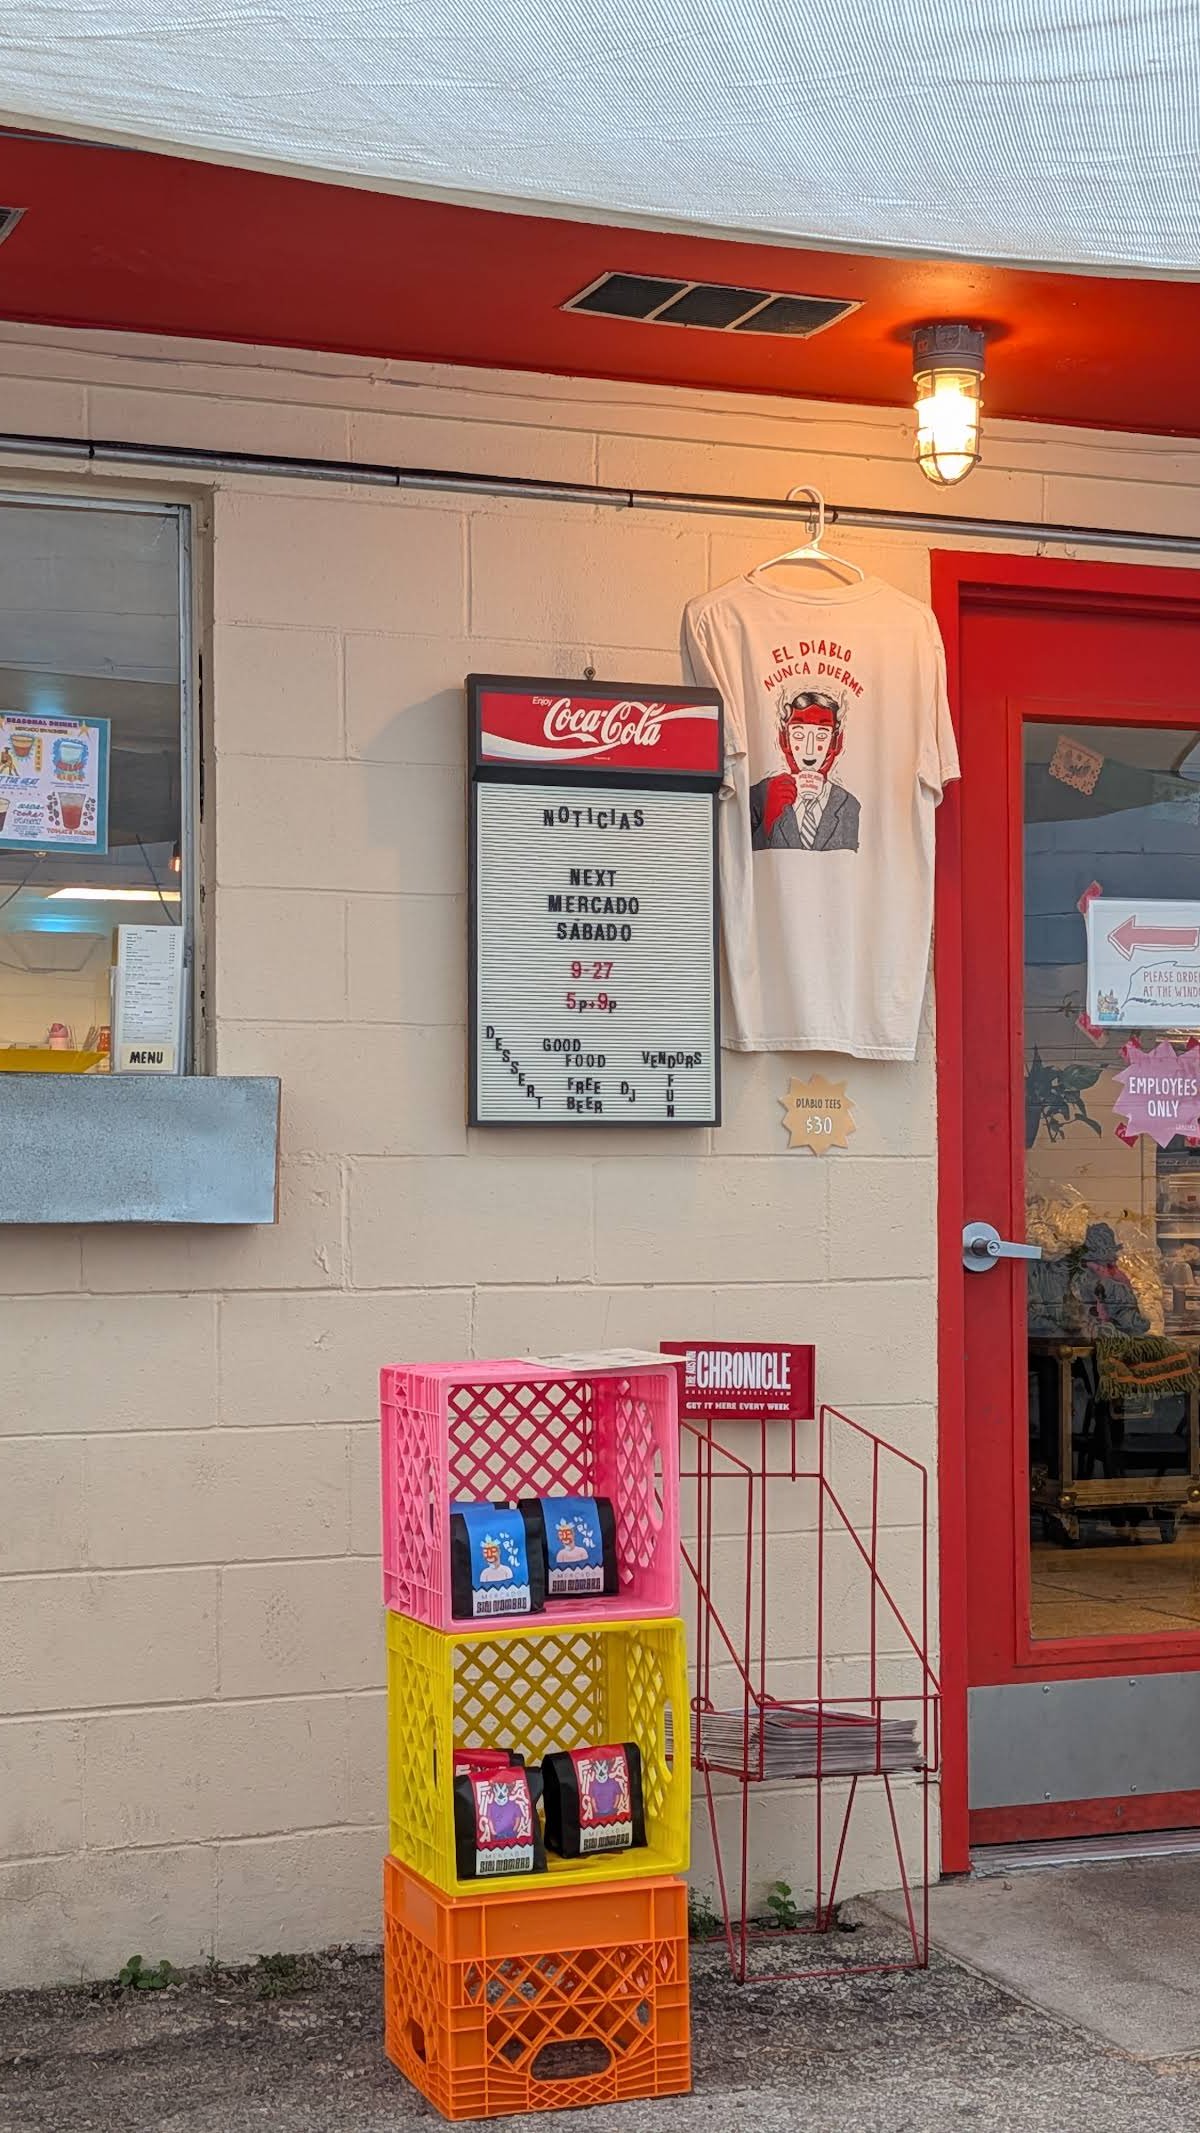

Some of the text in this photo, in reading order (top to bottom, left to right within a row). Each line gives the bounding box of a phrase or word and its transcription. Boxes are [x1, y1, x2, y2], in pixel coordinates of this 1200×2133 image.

[772, 639, 852, 664] EL DIABLO
[764, 661, 864, 698] NUNCA DUERME
[532, 696, 553, 707] Enjoy
[543, 698, 666, 746] Coca-Cola
[543, 806, 645, 830] NOTICIAS
[570, 868, 617, 887] NEXT
[548, 895, 640, 915] MERCADO
[571, 960, 614, 980] 9-27
[1143, 970, 1200, 983] PLEASE ORDE
[1143, 985, 1153, 997] AT
[1156, 985, 1172, 998] THE
[543, 1038, 582, 1052] GOOD
[129, 1051, 164, 1064] MENU
[565, 1054, 606, 1068] FOOD
[641, 1050, 702, 1069] VENDORS
[567, 1077, 601, 1095] FREE
[620, 1080, 636, 1102] DJ
[1129, 1076, 1198, 1097] EMPLOYEES
[566, 1096, 603, 1113] BEER
[666, 1074, 675, 1118] FUN
[795, 1097, 842, 1109] DIABLO TEES
[1147, 1100, 1180, 1118] ONLY
[806, 1115, 832, 1135] $30
[696, 1350, 792, 1390] CHRONICLE
[685, 1402, 790, 1411] GET IT HERE EVERY WEEK
